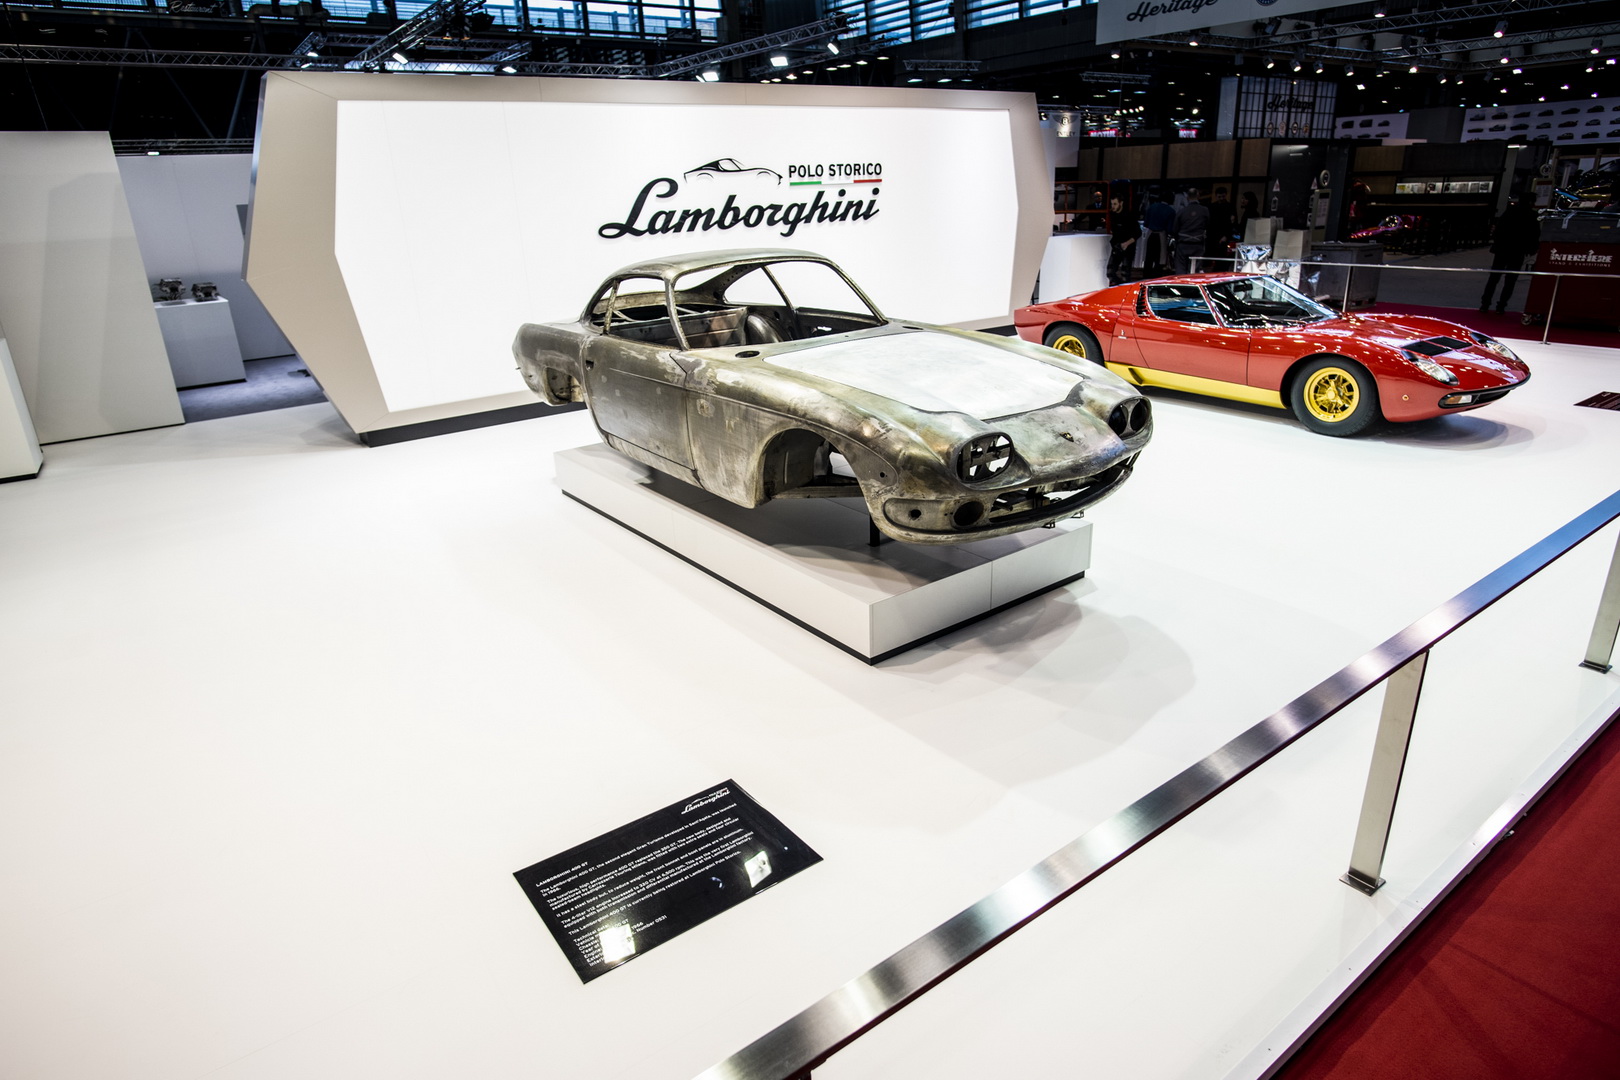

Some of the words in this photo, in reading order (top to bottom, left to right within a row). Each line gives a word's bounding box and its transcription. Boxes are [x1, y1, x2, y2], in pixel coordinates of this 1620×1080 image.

[169, 1, 217, 13] Restaurant
[1126, 0, 1218, 22] Heritage
[788, 164, 824, 178] POLO
[828, 162, 882, 176] STORICO
[598, 177, 880, 238] Lamborghini
[681, 790, 730, 814] Lamborghini
[549, 874, 578, 889] Lamborghini
[604, 855, 620, 864] second
[620, 848, 636, 857] elegant
[646, 836, 664, 844] Turismo
[664, 826, 684, 837] developed
[719, 803, 736, 812] launched
[590, 869, 617, 884] performance
[634, 853, 653, 863] replaced
[706, 820, 723, 830] designed
[549, 890, 581, 906] manufactured
[614, 867, 631, 876] Touring
[724, 817, 738, 826] circular
[613, 881, 629, 890] reduce
[664, 857, 679, 866] bonnet
[698, 843, 711, 851] panels
[535, 869, 570, 886] LAMBORGHINI
[563, 915, 585, 928] equipped
[607, 891, 636, 907] transmission
[669, 861, 698, 877] manufactured
[711, 843, 736, 857] Lamborghini
[571, 910, 585, 919] 4-liter
[596, 899, 611, 908] engine
[611, 888, 633, 900] increased
[728, 831, 753, 844] Lamborghini
[552, 895, 581, 910] sealed-beam
[579, 913, 609, 930] Lamborghini
[631, 893, 652, 905] currently
[665, 877, 684, 888] restored
[688, 862, 715, 877] Lamborghini
[574, 930, 596, 942] Technical
[636, 921, 655, 932] Number
[576, 936, 594, 946] Vehicle
